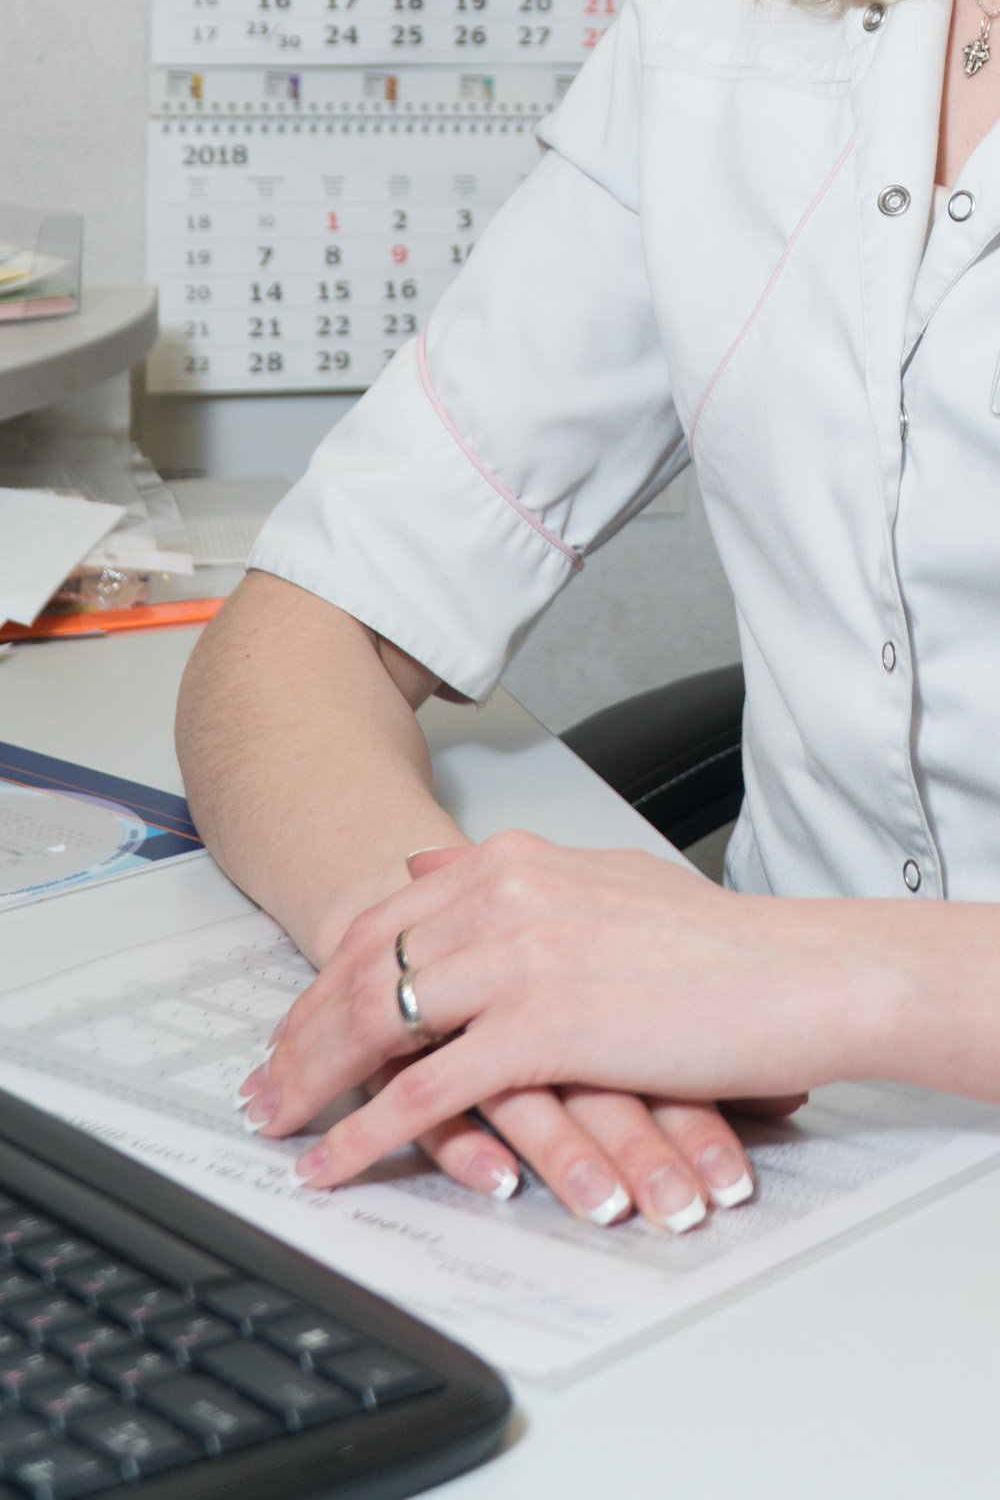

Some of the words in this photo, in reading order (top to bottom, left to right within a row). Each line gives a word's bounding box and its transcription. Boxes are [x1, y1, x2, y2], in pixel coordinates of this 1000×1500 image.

[192, 25, 219, 45] 17
[325, 25, 359, 46] 24
[391, 25, 424, 47] 25
[455, 25, 487, 48] 26
[518, 25, 551, 48] 27
[183, 144, 249, 167] 2018
[186, 213, 213, 232] 18
[327, 211, 339, 232] 1
[393, 209, 408, 231] 2
[459, 209, 474, 230] 3
[186, 249, 212, 268] 19
[258, 246, 274, 268] 7
[324, 245, 342, 267] 8
[391, 245, 408, 265] 9
[185, 284, 213, 303] 20
[251, 282, 284, 304] 14
[318, 280, 352, 303] 15
[385, 279, 419, 302] 16
[184, 320, 211, 339] 21
[249, 317, 282, 339] 21
[317, 315, 351, 338] 22
[384, 313, 418, 337] 23
[184, 356, 211, 374] 22
[249, 352, 284, 374] 28
[317, 351, 351, 373] 29
